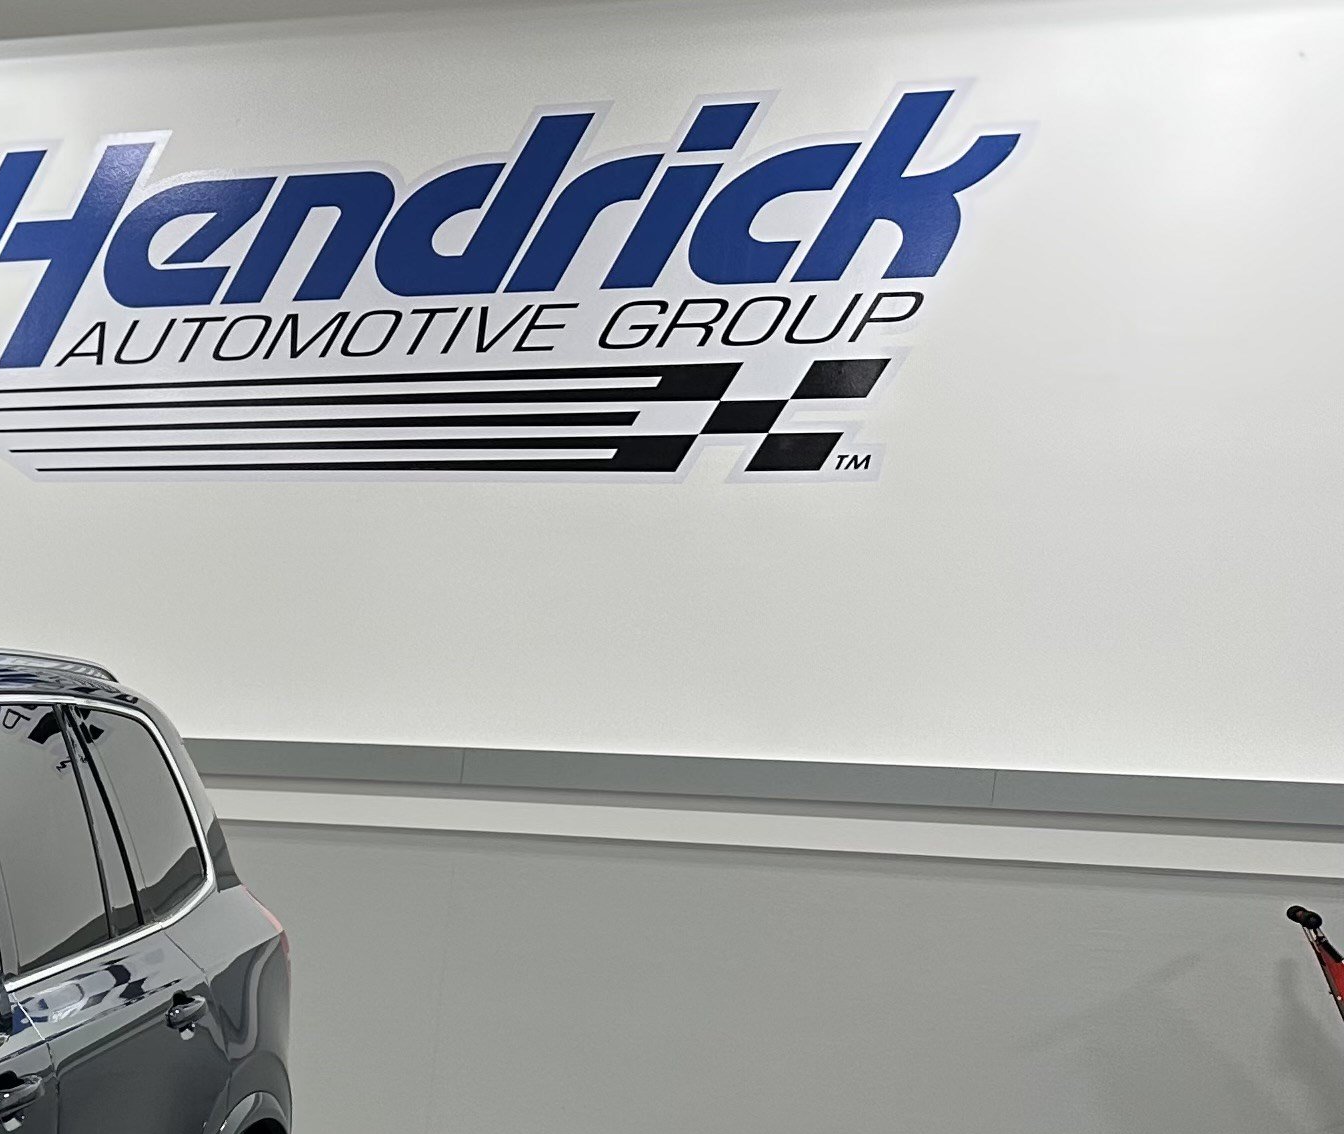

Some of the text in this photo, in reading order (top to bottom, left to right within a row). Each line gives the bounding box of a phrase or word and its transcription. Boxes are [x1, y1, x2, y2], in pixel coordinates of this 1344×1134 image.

[55, 291, 924, 367] AUTOMOTIVE GROUP
[835, 454, 872, 470] TM
